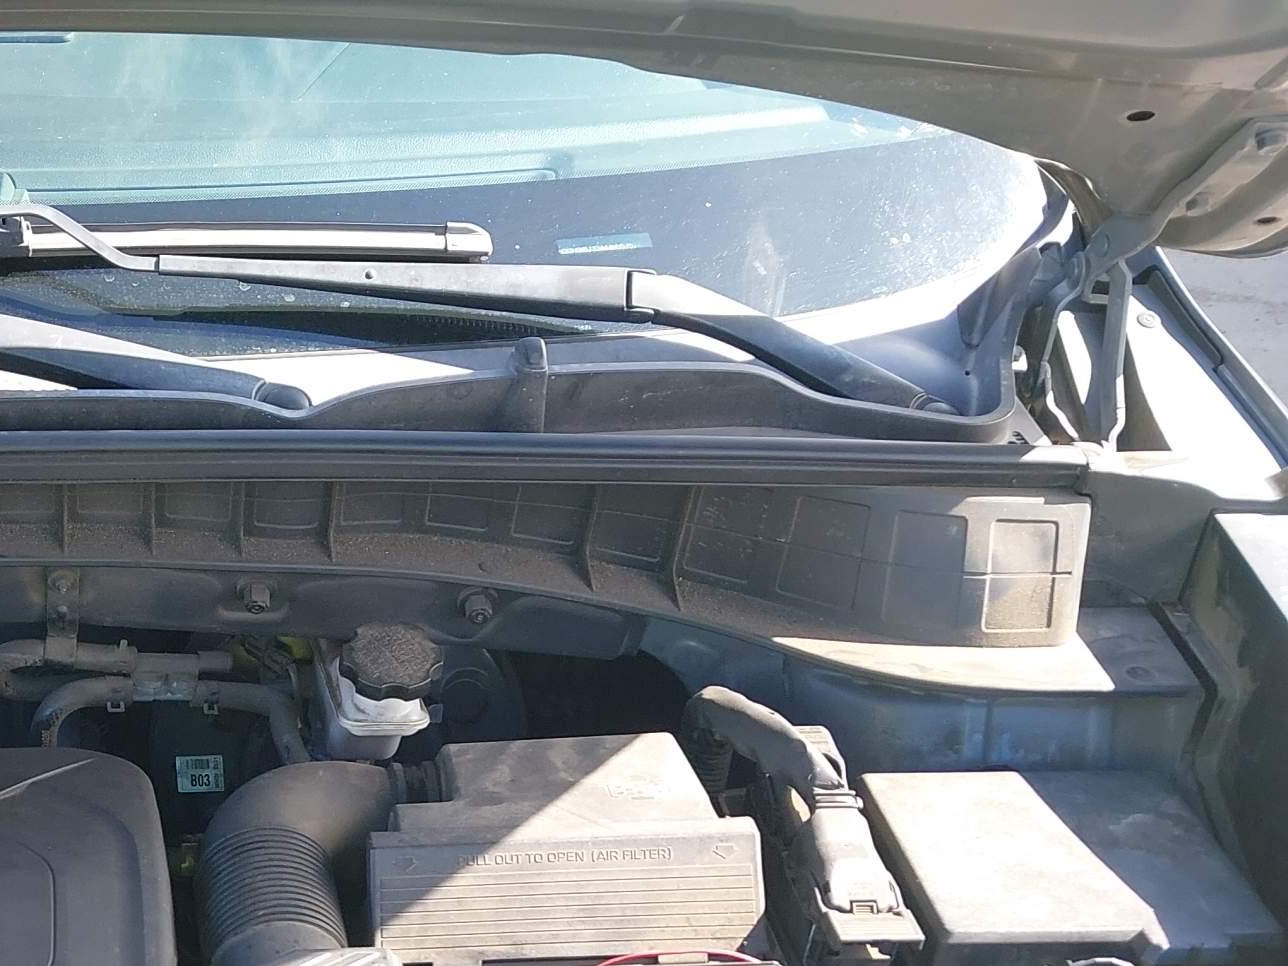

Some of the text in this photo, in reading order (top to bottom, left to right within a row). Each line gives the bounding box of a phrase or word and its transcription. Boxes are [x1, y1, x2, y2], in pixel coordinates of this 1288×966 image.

[190, 773, 210, 787] B03
[456, 847, 672, 866] PULL OUT TO OPEN (AIR FILTER)
